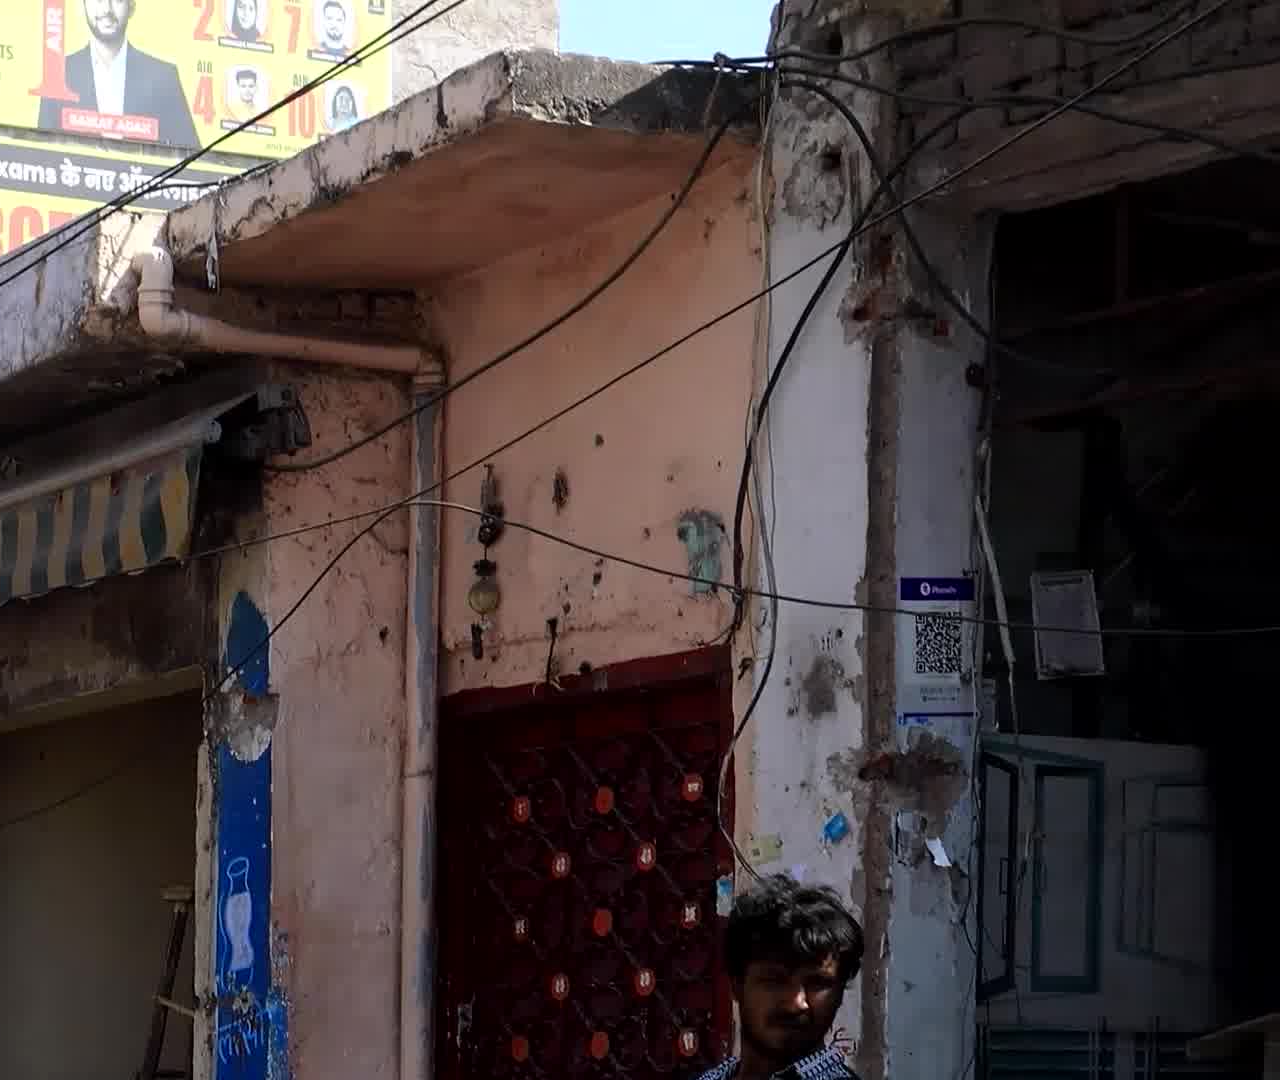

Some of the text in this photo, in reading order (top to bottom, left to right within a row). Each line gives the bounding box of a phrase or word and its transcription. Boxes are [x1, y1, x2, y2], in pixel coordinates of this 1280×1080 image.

[285, 4, 301, 54] 7
[193, 75, 215, 126] 4
[60, 157, 82, 188] के
